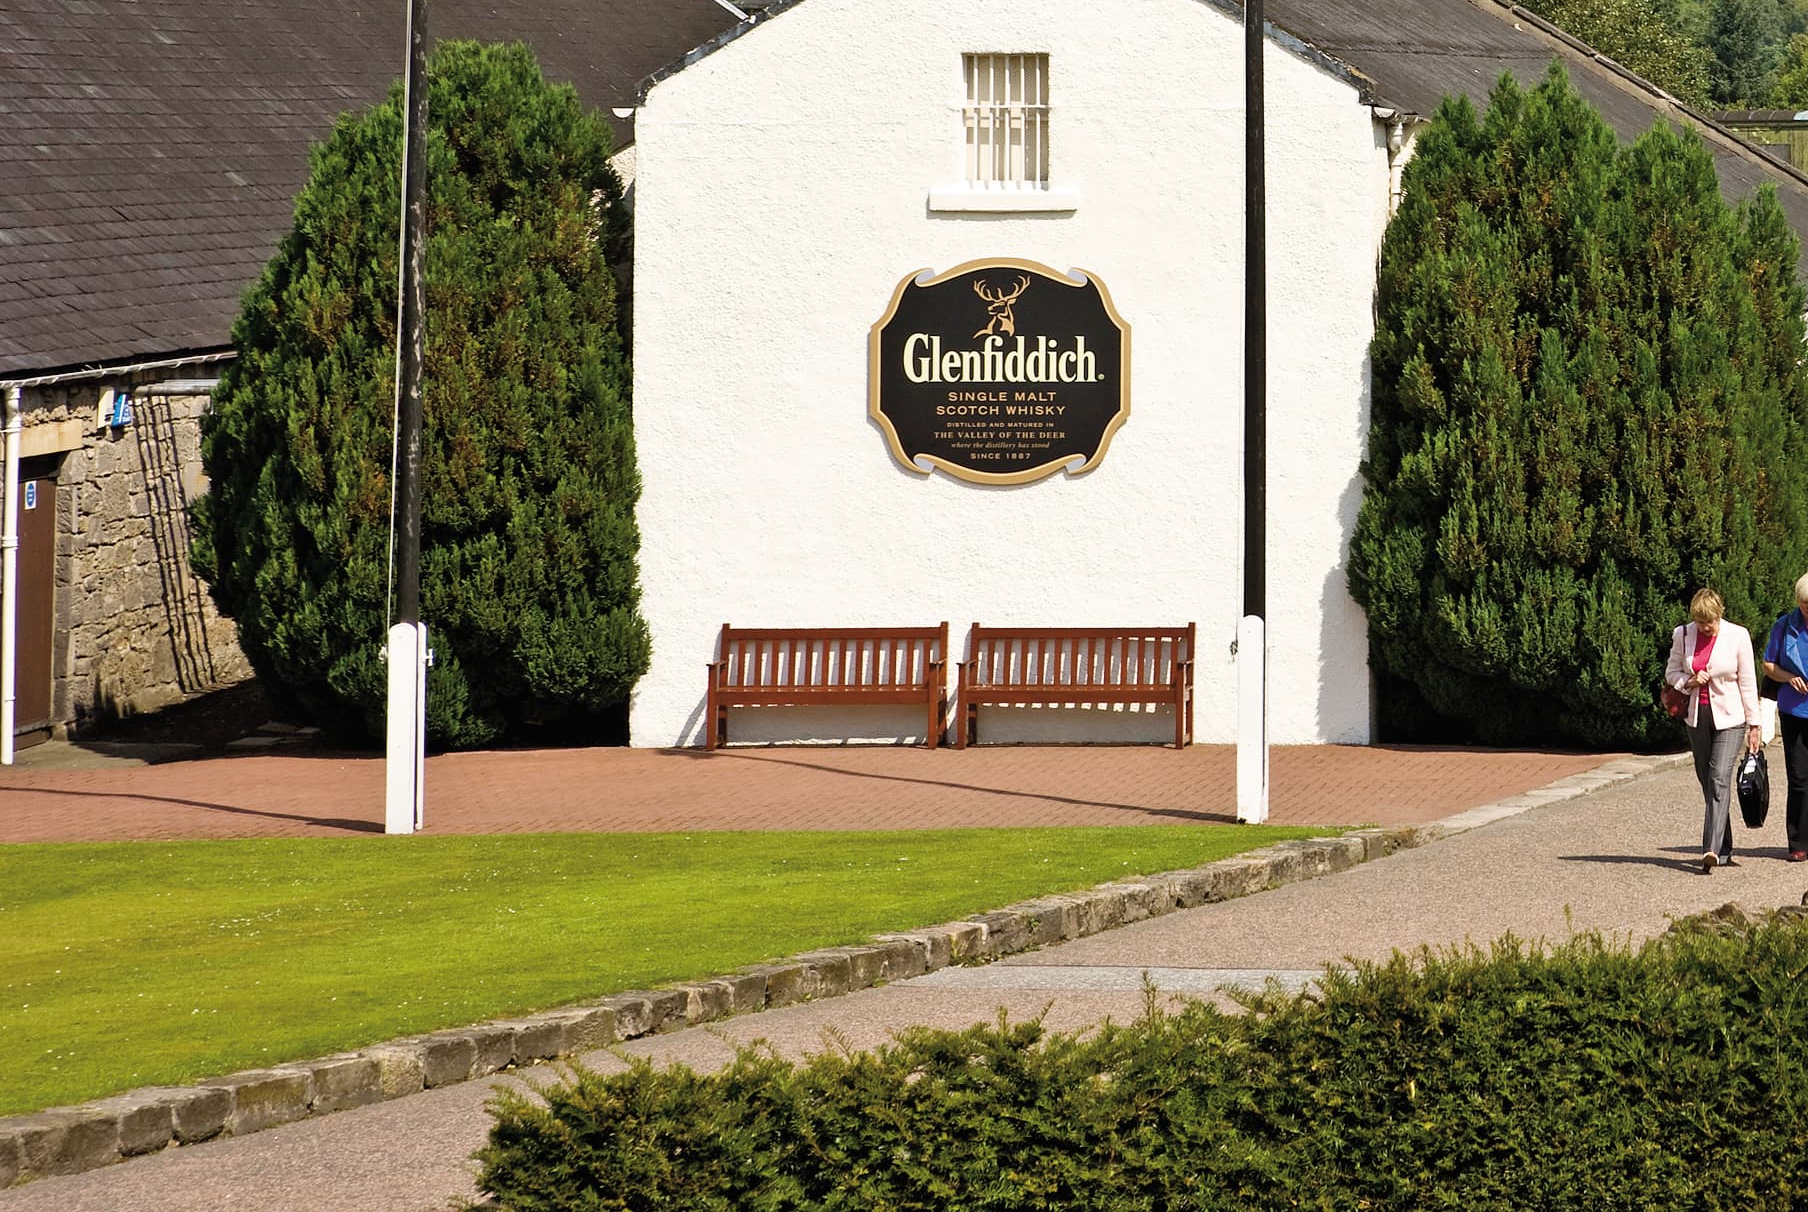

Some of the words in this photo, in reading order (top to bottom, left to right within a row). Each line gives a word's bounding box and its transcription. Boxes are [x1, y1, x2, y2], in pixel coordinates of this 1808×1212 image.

[948, 391, 1008, 402] SINGLE
[1014, 391, 1057, 402] MALT
[936, 405, 999, 415] SCOTCH
[1005, 405, 1066, 415] WHISKY
[934, 431, 954, 439] THE
[957, 431, 995, 439] VALLEY
[998, 431, 1013, 439] OF
[1015, 431, 1036, 439] THE
[1039, 431, 1066, 439] DEER
